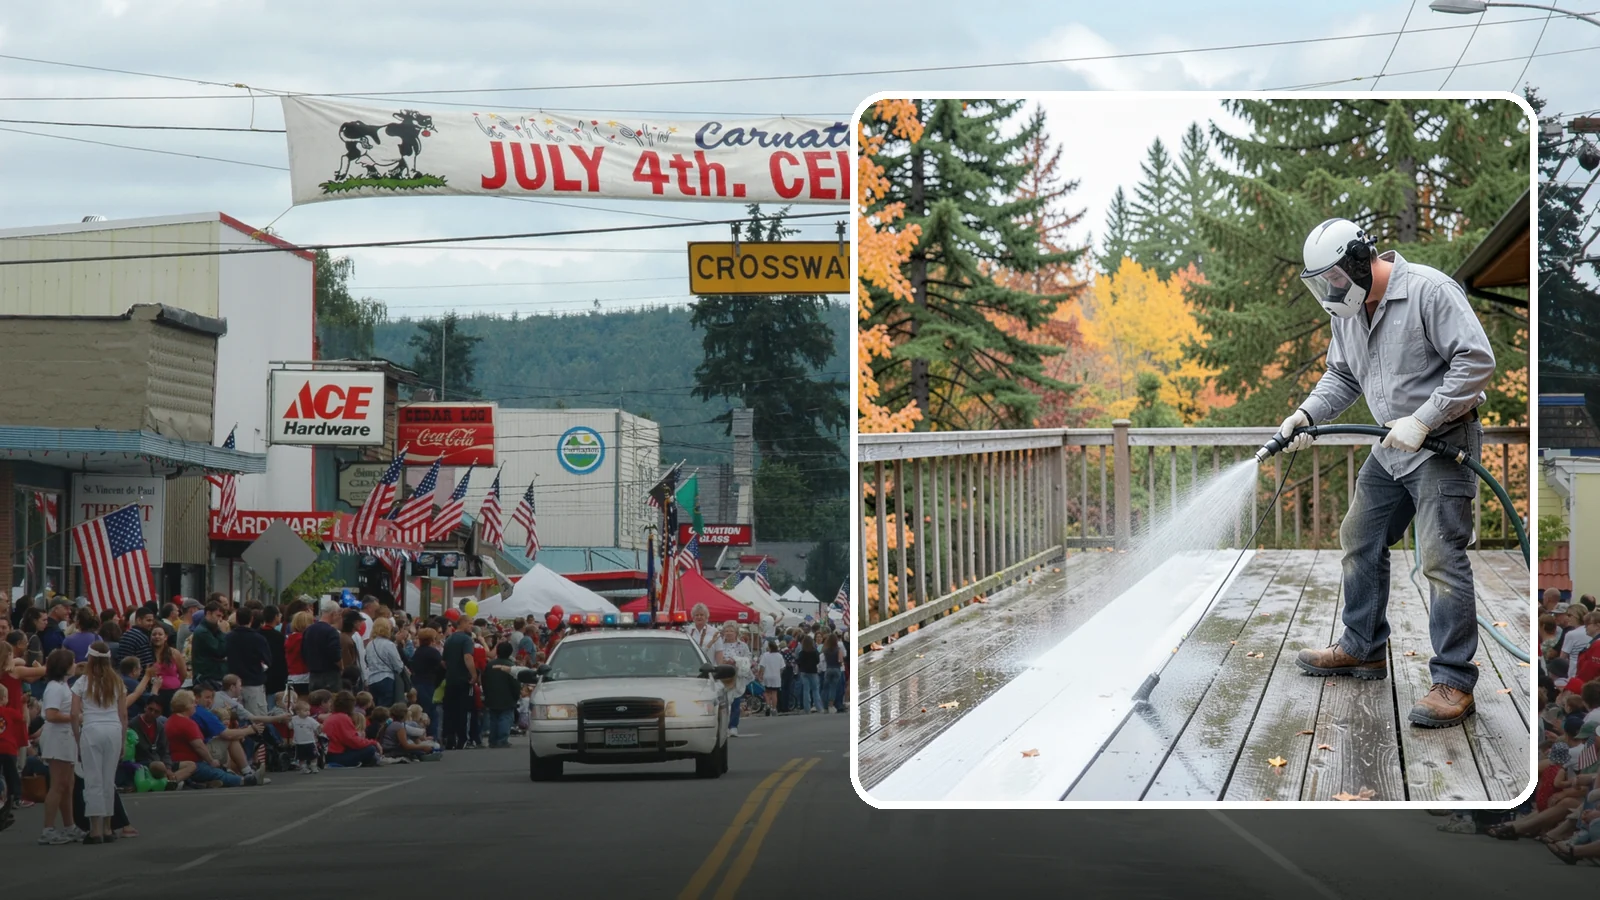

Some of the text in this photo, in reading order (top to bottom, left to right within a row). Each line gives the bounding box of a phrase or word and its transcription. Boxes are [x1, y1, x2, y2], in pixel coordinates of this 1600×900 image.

[695, 121, 850, 149] Carnat
[481, 141, 605, 192] JULY
[632, 150, 746, 198] 4th.
[697, 254, 850, 280] CROSSWA
[282, 380, 373, 420] ACE
[406, 409, 485, 422] CEDAR LOG
[283, 421, 370, 436] Hardware
[95, 485, 124, 495] Vincent
[126, 486, 136, 495] de
[138, 486, 155, 495] Paul
[688, 526, 741, 535] CRNATION
[699, 535, 730, 543] GLASS
